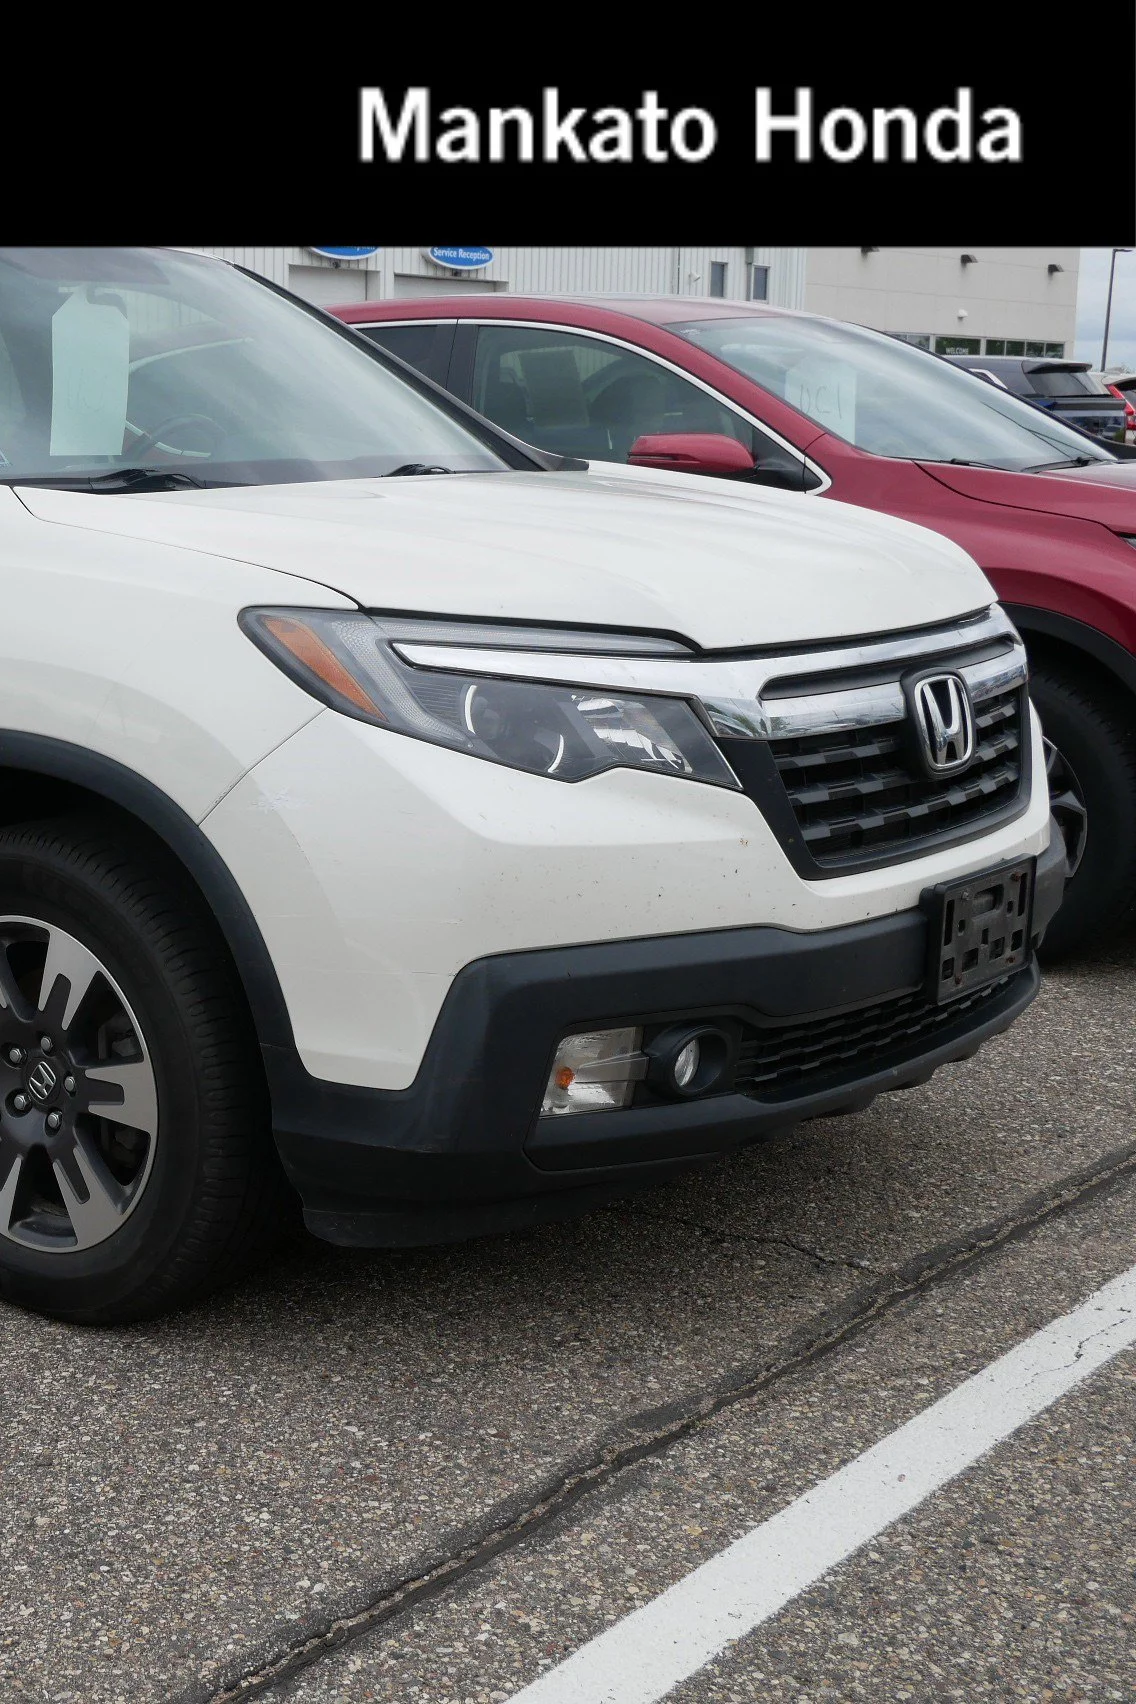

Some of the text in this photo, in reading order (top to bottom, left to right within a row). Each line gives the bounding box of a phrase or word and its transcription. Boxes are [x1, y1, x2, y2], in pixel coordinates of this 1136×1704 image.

[433, 247, 490, 261] Service Reception
[945, 347, 969, 355] WELCOME
